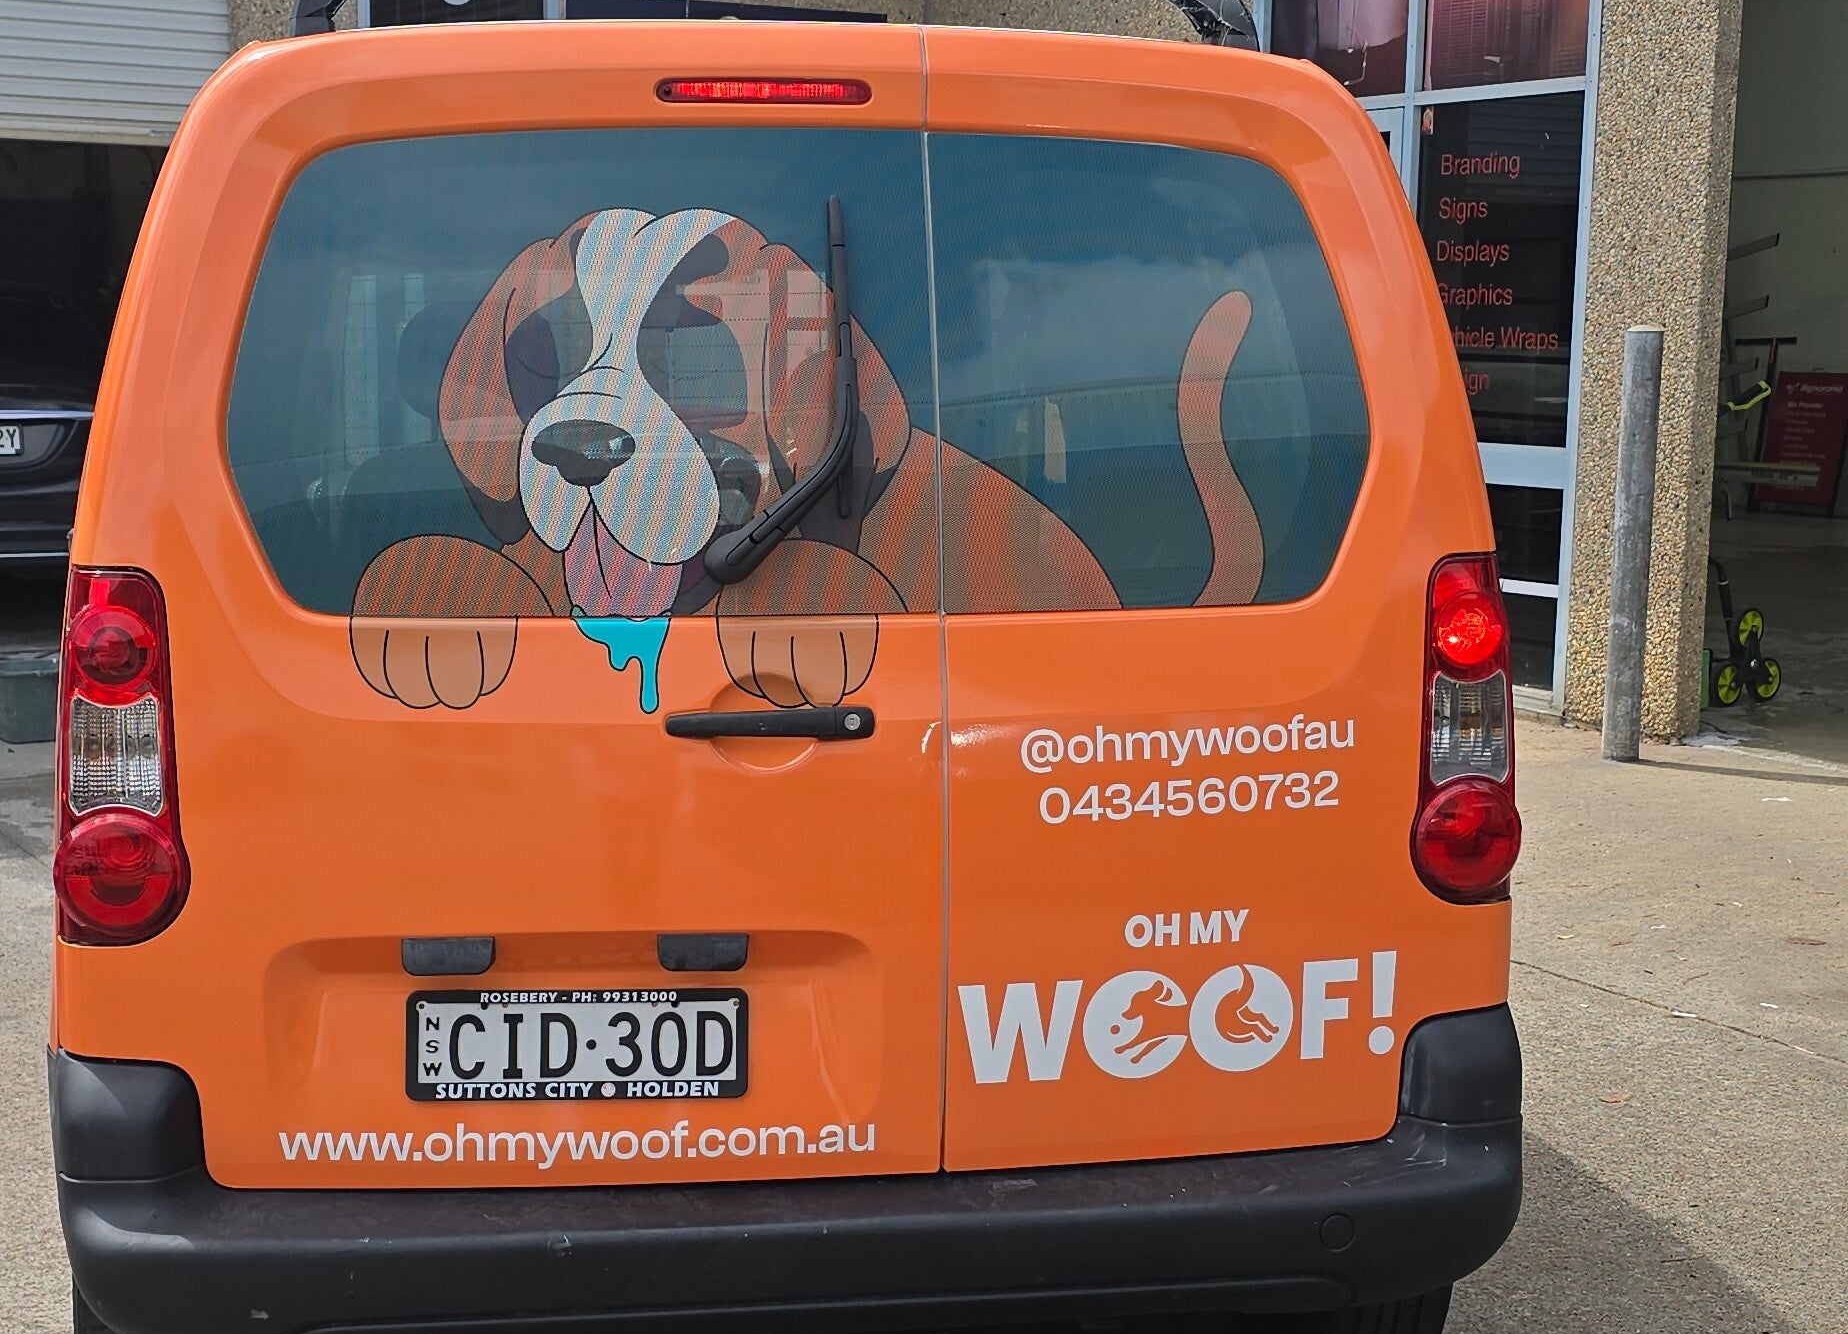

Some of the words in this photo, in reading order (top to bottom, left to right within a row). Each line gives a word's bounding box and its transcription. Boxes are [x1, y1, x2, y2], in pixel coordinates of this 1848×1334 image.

[1441, 152, 1521, 179] Branding
[1439, 197, 1488, 225] Signs
[1436, 239, 1510, 267] Displays
[1438, 283, 1513, 310] Graphics
[1501, 326, 1559, 354] Wraps
[1020, 713, 1355, 775] @ohmywoofau
[1038, 770, 1340, 825] 0434560732
[1124, 913, 1180, 948] OH
[1188, 908, 1250, 944] MY
[480, 992, 558, 1003] ROSEBERY
[571, 992, 597, 1003] PH:
[602, 991, 678, 1002] 99313000
[956, 949, 1398, 1085] WOOF!
[435, 1082, 537, 1099] SUTTONS
[544, 1082, 594, 1098] CITY
[626, 1081, 720, 1097] HOLDEN
[278, 1119, 876, 1171] www.ohmywoof.com.au
